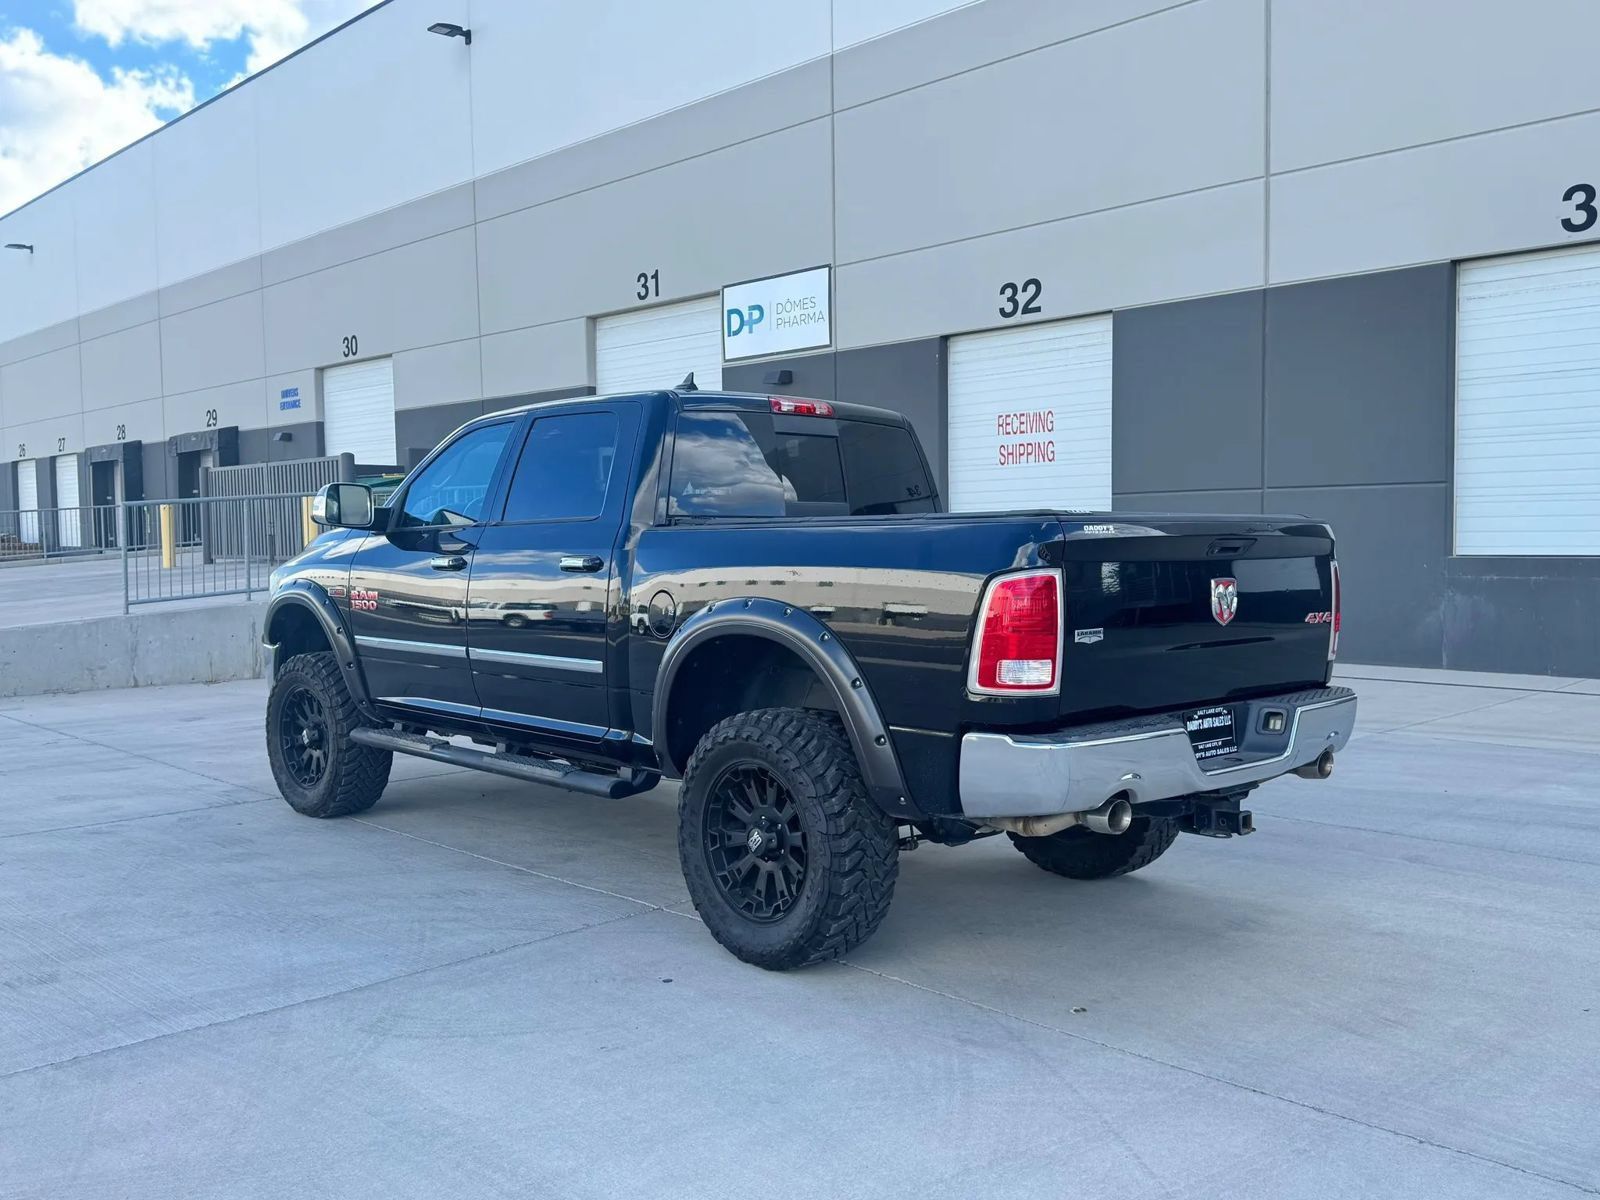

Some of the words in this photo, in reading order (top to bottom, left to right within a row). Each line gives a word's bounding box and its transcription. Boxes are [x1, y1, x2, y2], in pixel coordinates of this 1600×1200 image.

[1560, 183, 1598, 233] 3
[636, 269, 660, 301] 31
[775, 296, 817, 315] DÔMES
[998, 278, 1042, 319] 32
[775, 311, 826, 330] PHARMA
[342, 334, 358, 358] 30
[206, 408, 218, 428] 29
[997, 410, 1054, 436] RECEIVING
[116, 424, 126, 440] 28
[18, 443, 26, 457] 26
[58, 437, 66, 452] 27
[998, 440, 1055, 466] SHIPPING
[351, 590, 378, 600] RAM
[351, 600, 378, 610] 1500
